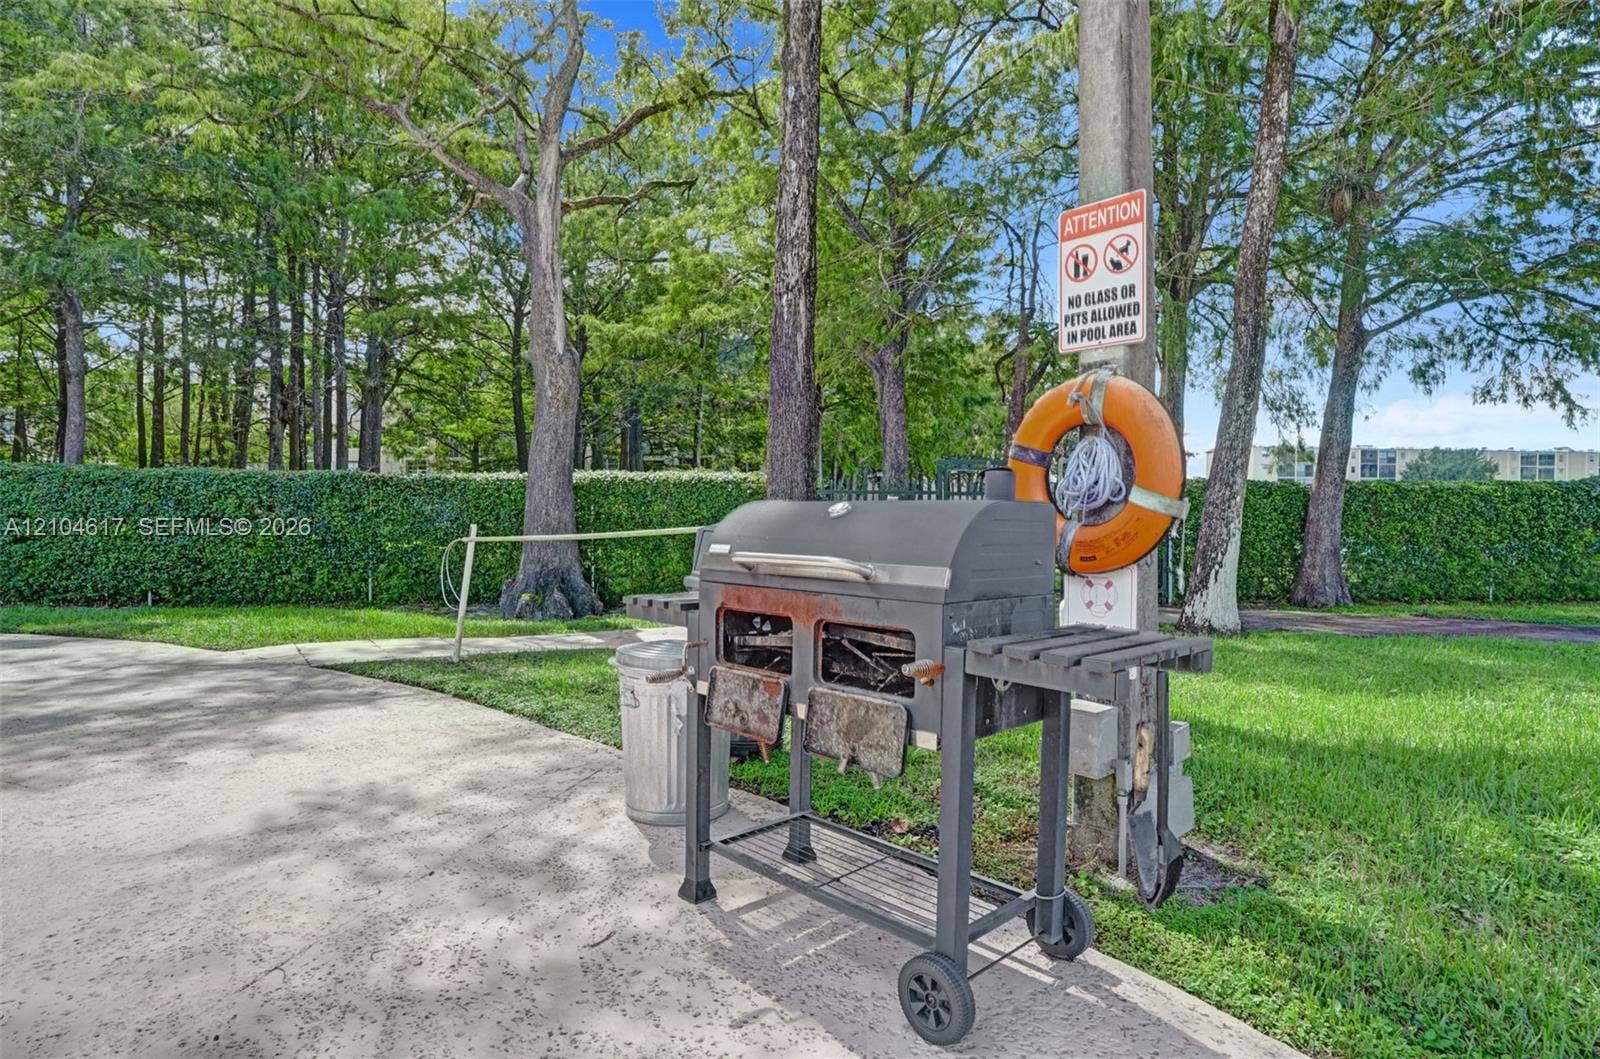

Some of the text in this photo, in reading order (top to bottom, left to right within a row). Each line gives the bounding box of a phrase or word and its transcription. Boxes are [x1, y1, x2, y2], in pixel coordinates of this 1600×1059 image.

[1064, 198, 1141, 236] ATTENTION
[1068, 283, 1136, 310] NO GLASS OR
[1064, 301, 1140, 328] PETS ALLOWED
[1067, 320, 1137, 344] IN POOL AREA
